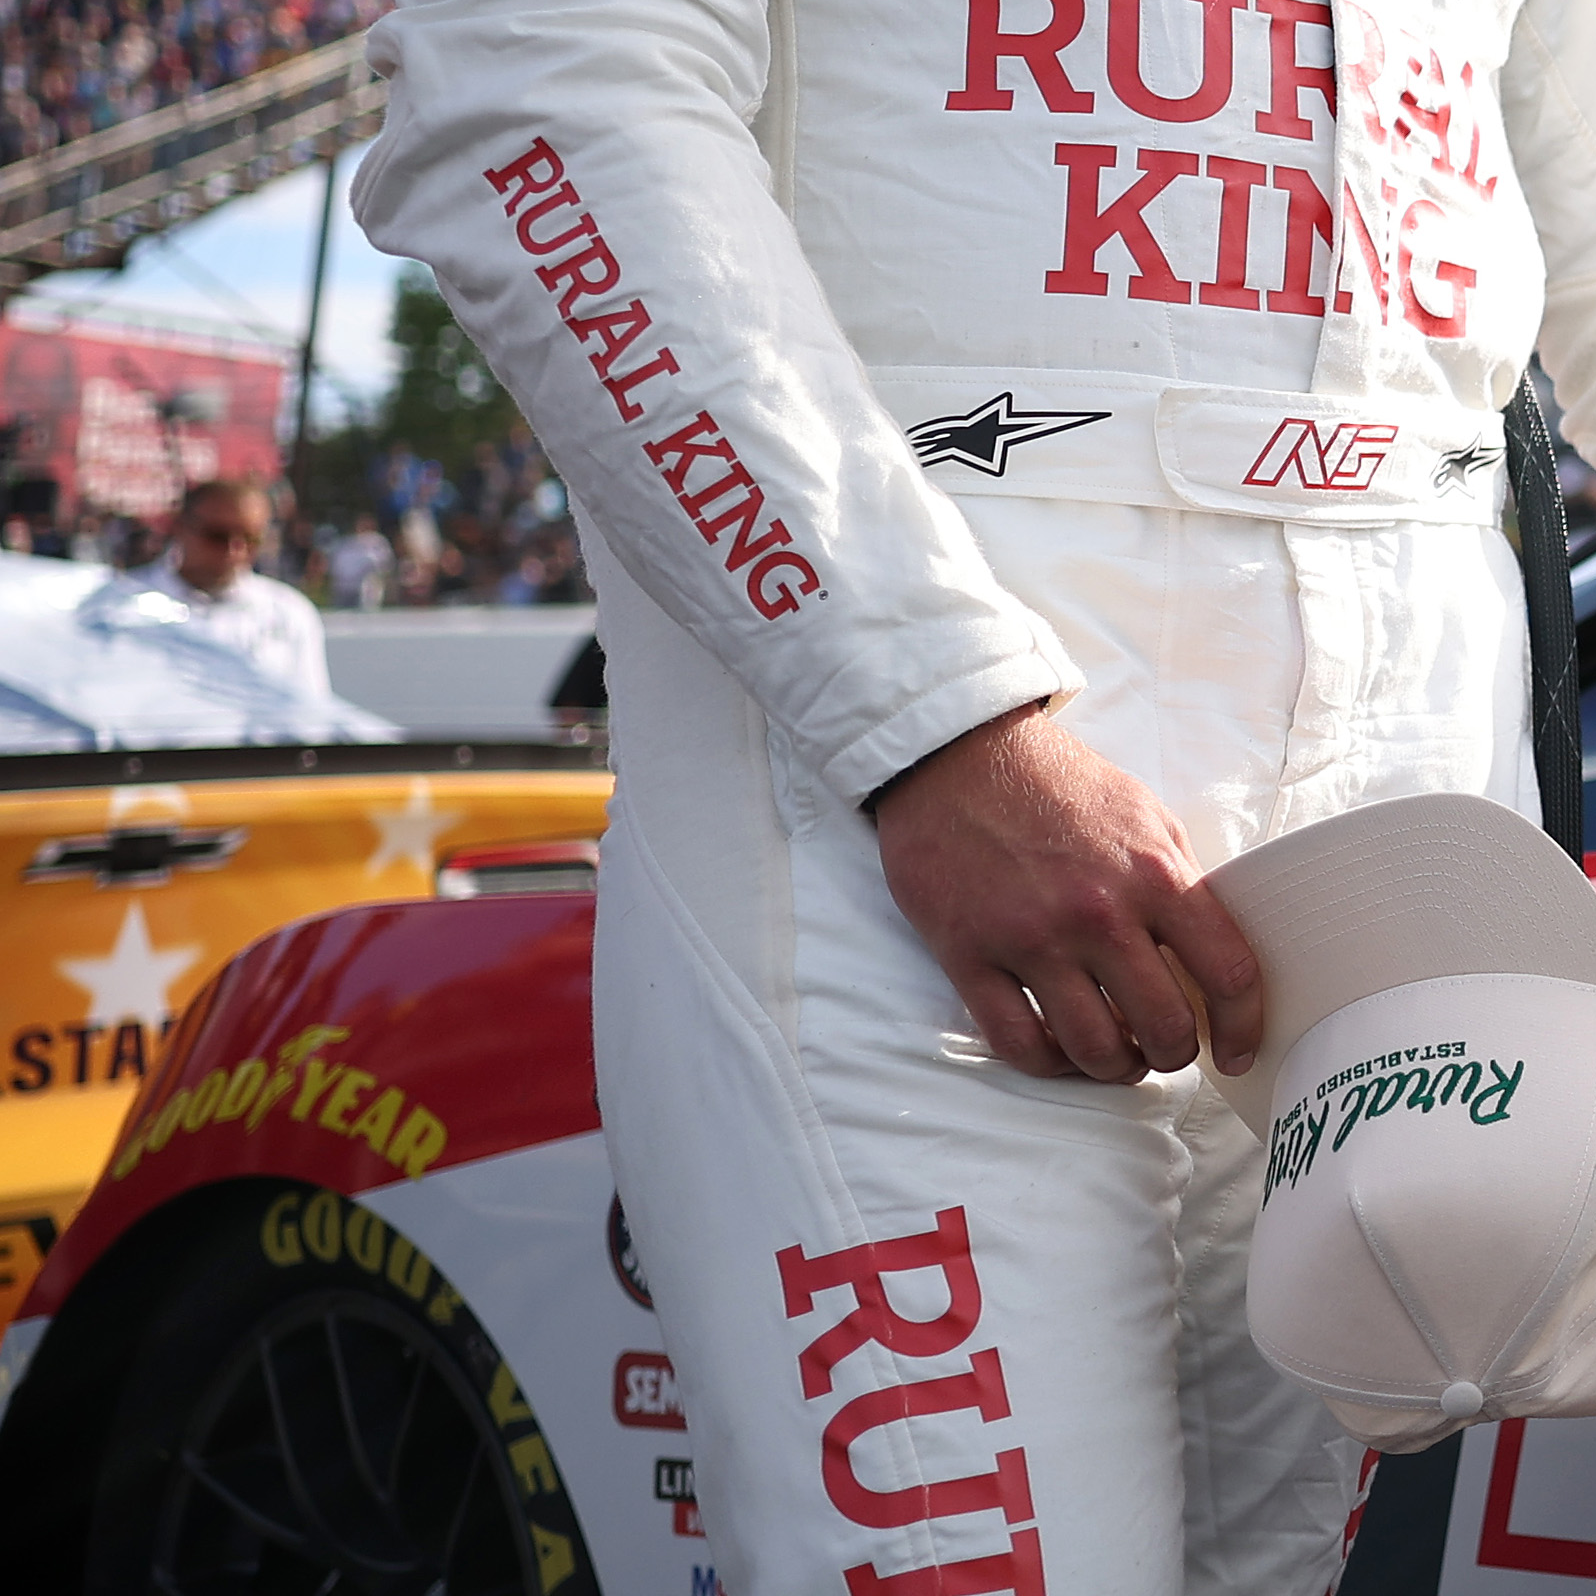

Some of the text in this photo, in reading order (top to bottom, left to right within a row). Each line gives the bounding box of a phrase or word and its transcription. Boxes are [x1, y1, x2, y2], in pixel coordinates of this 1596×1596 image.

[1043, 142, 1478, 341] KING
[482, 135, 822, 622] RURAL KING
[113, 1052, 448, 1181] GOODYEAR
[1315, 1041, 1467, 1101] ESTABLISHED
[1331, 1059, 1525, 1152] Rural
